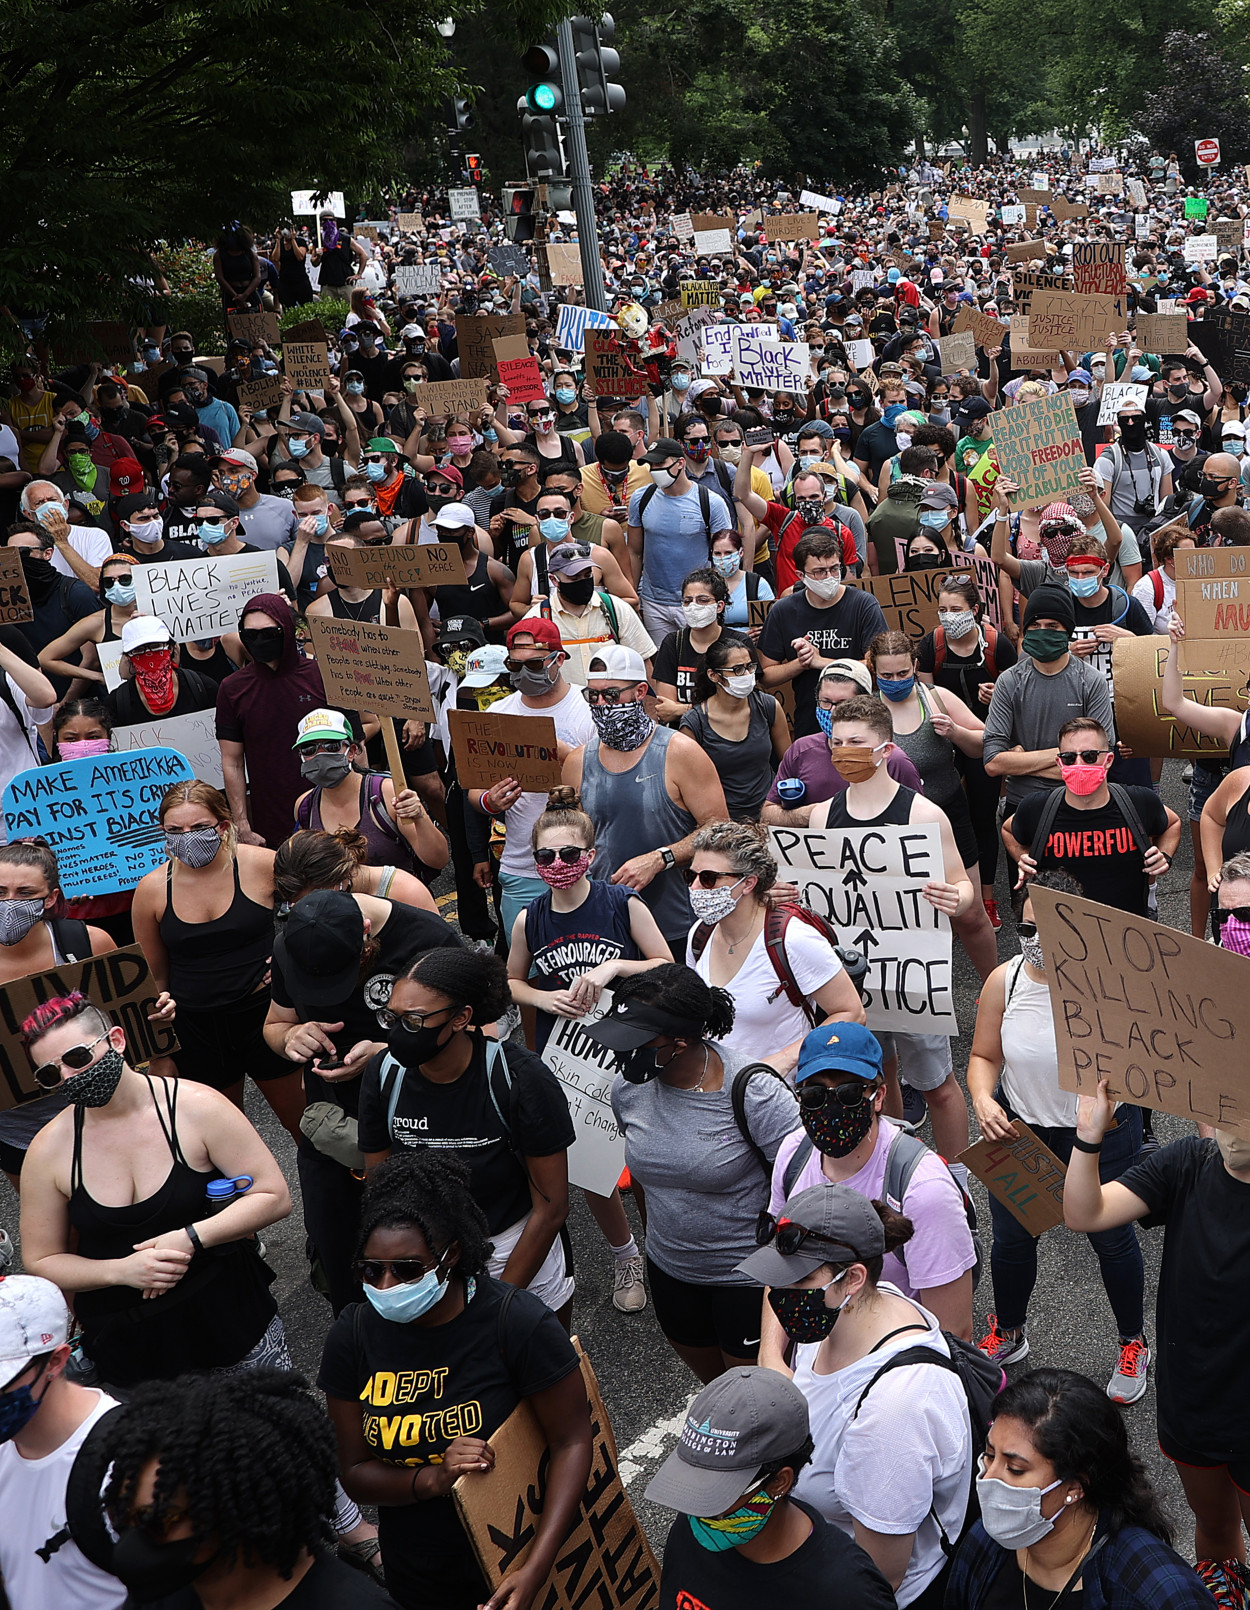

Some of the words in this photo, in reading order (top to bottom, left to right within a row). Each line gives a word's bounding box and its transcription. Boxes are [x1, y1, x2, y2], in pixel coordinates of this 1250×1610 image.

[766, 217, 784, 227] BLUE
[787, 217, 812, 226] LIVES
[767, 225, 803, 236] MURDER
[1073, 243, 1098, 266] ROOT
[1100, 242, 1125, 264] OUT
[396, 266, 429, 277] SILENCE
[431, 266, 439, 275] IS
[854, 271, 875, 281] BLACK
[1073, 263, 1126, 282] STRUCTURAL
[403, 275, 440, 288] VIOLENCE
[1015, 272, 1070, 291] SILENCE
[1075, 279, 1127, 295] VIOLENCE
[687, 292, 719, 305] MATTER
[233, 316, 269, 330] BLACK
[1032, 314, 1074, 326] JUSTICE
[475, 326, 506, 345] SAY
[1031, 325, 1075, 335] JUSTICE
[287, 345, 315, 354] WHITE
[1033, 336, 1056, 348] WE
[1062, 336, 1086, 348] SHALL
[288, 354, 322, 364] SILENCE
[466, 345, 492, 359] THE
[500, 361, 535, 372] SILENCE
[1016, 355, 1058, 365] ABOLISH
[289, 368, 328, 378] VIOLENCE
[296, 378, 324, 388] #BLM
[427, 383, 449, 392] WILL
[451, 380, 480, 390] NEVER
[595, 378, 646, 395] SILENCE
[430, 405, 435, 415] I
[443, 397, 480, 412] STAND
[989, 414, 1002, 428] IF
[1003, 400, 1044, 424] YOU'RE
[1045, 392, 1070, 412] NOT
[993, 419, 1031, 444] READY
[1034, 415, 1052, 431] TO
[1053, 408, 1074, 427] DIE
[996, 440, 1019, 459] FOR
[1019, 436, 1031, 452] IT
[1033, 429, 1056, 448] PUT
[1057, 422, 1081, 441] THE
[1000, 454, 1031, 474] WORD
[1031, 438, 1084, 465] FREEDOM
[332, 552, 349, 567] NO
[359, 548, 416, 563] DEFUND
[427, 548, 448, 561] NO
[428, 563, 456, 573] PEACE
[1186, 554, 1217, 576] WHO
[1229, 554, 1248, 573] DO
[147, 563, 221, 594] BLACK
[1201, 580, 1240, 600] WHEN
[151, 589, 221, 617] LIVES
[806, 628, 839, 639] SEEK
[461, 720, 494, 738] THE
[467, 740, 560, 762] REVOLUTION
[467, 758, 482, 770] IS
[484, 757, 519, 772] NOW
[11, 770, 78, 803] MAKE
[90, 755, 186, 788] AMERIKKKA
[5, 807, 42, 832] PAY
[49, 799, 89, 822] FOR
[91, 789, 135, 814] IT'S
[125, 852, 144, 862] NO
[772, 830, 931, 878] PEACE
[128, 863, 145, 871] NO
[1054, 902, 1183, 981] STOP
[1051, 952, 1238, 1042] KILLING
[1063, 999, 1206, 1069] BLACK
[1072, 1046, 1241, 1128] PEOPLE
[993, 1170, 1032, 1216] ALL
[711, 1428, 740, 1437] UNIVERSITY
